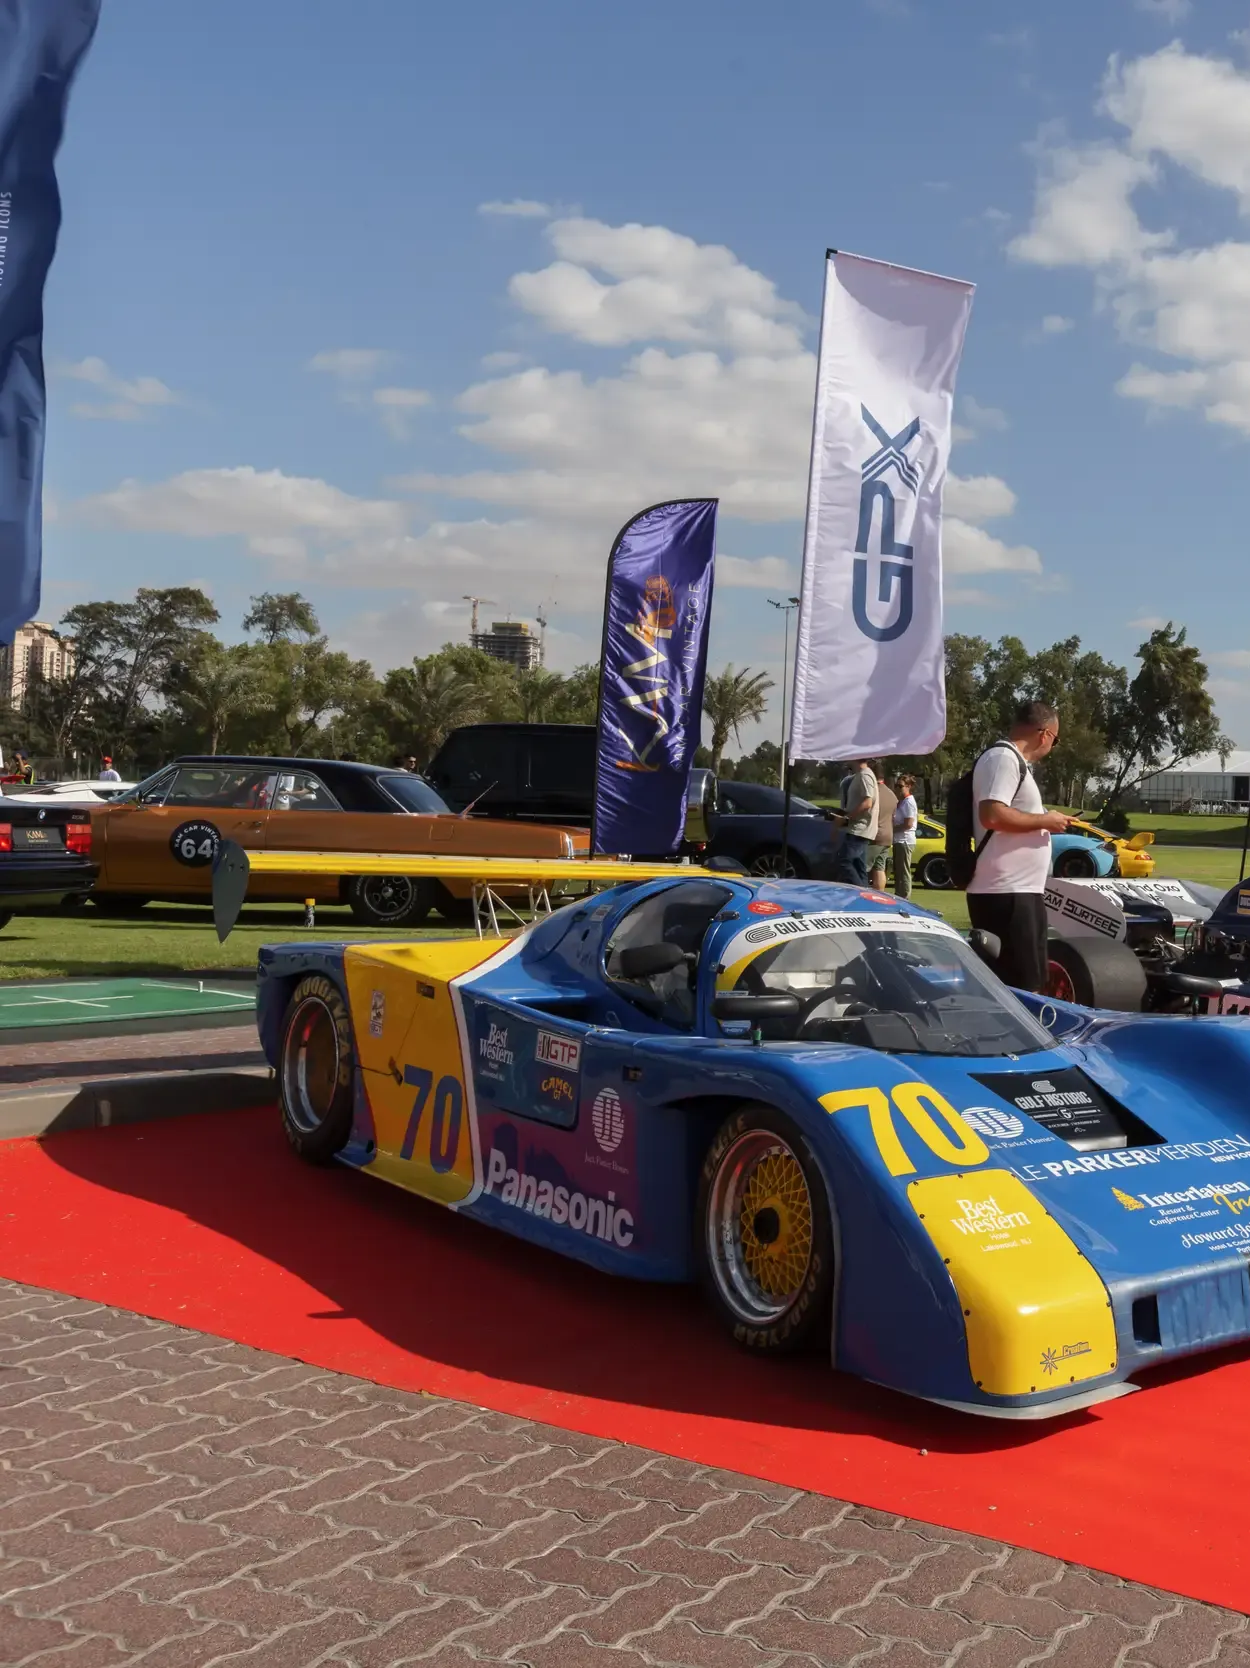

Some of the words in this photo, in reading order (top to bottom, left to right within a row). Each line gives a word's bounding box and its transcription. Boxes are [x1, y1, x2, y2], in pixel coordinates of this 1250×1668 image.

[852, 402, 920, 643] GPX
[681, 582, 702, 674] VINTAGE
[677, 685, 693, 727] CAR
[181, 838, 213, 859] 64
[1153, 880, 1180, 893] Oxo
[773, 919, 810, 936] GULF
[809, 916, 872, 931] HISTORIC
[1062, 898, 1122, 940] SURTEES
[489, 1022, 509, 1048] Best
[479, 1037, 514, 1065] Western
[549, 1039, 578, 1065] GTP
[541, 1077, 574, 1101] CAMEL
[1014, 1095, 1045, 1109] GULF
[1042, 1091, 1093, 1107] HISTORIC
[400, 1063, 463, 1174] 70
[817, 1081, 991, 1177] 70
[1002, 1139, 1027, 1149] Parker
[1027, 1136, 1056, 1145] Homes
[1010, 1164, 1049, 1182] LE
[484, 1147, 634, 1248] Panasonic
[956, 1194, 1005, 1219] Best
[1158, 1207, 1185, 1217] Resort
[1186, 1204, 1195, 1212] &
[950, 1210, 1031, 1236] Western
[1181, 1226, 1237, 1249] Howard
